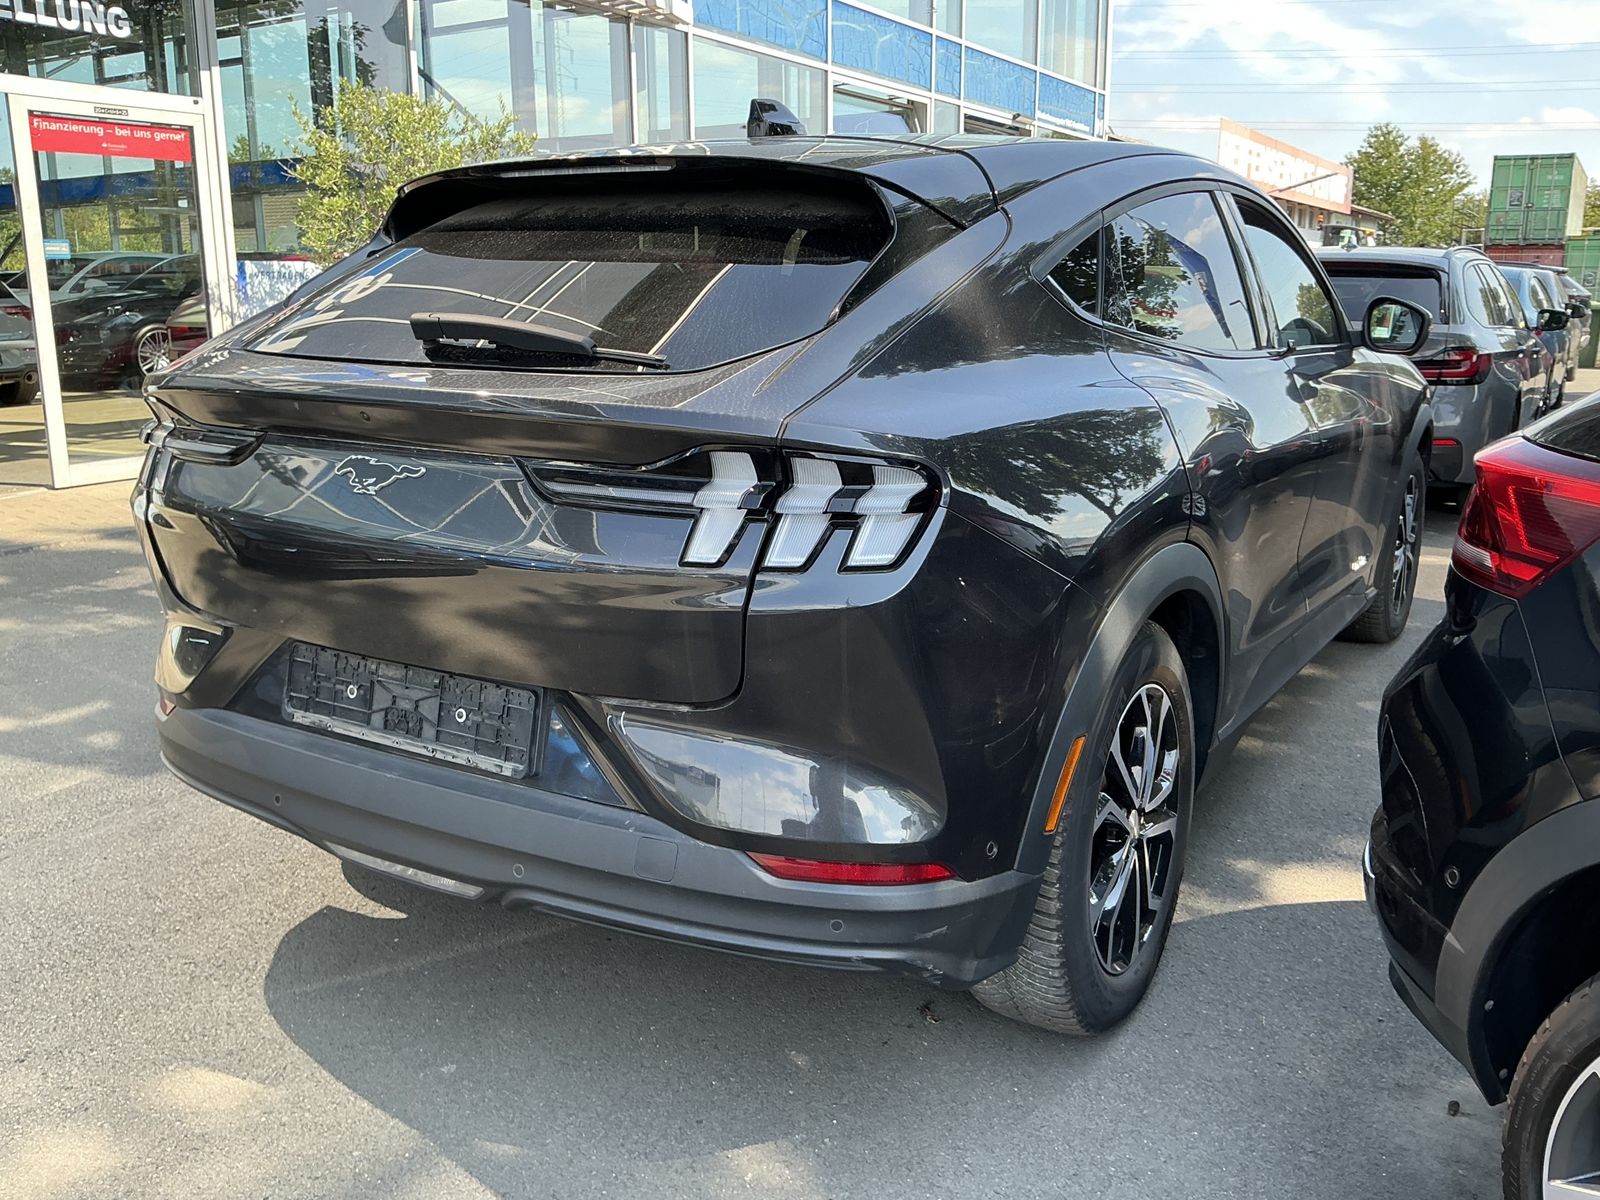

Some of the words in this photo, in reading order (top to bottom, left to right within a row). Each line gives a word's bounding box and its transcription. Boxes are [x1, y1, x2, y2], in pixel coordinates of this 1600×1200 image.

[33, 119, 104, 137] Finanzierung
[115, 126, 131, 138] bei
[134, 130, 152, 139] uns
[154, 132, 185, 142] gerne!
